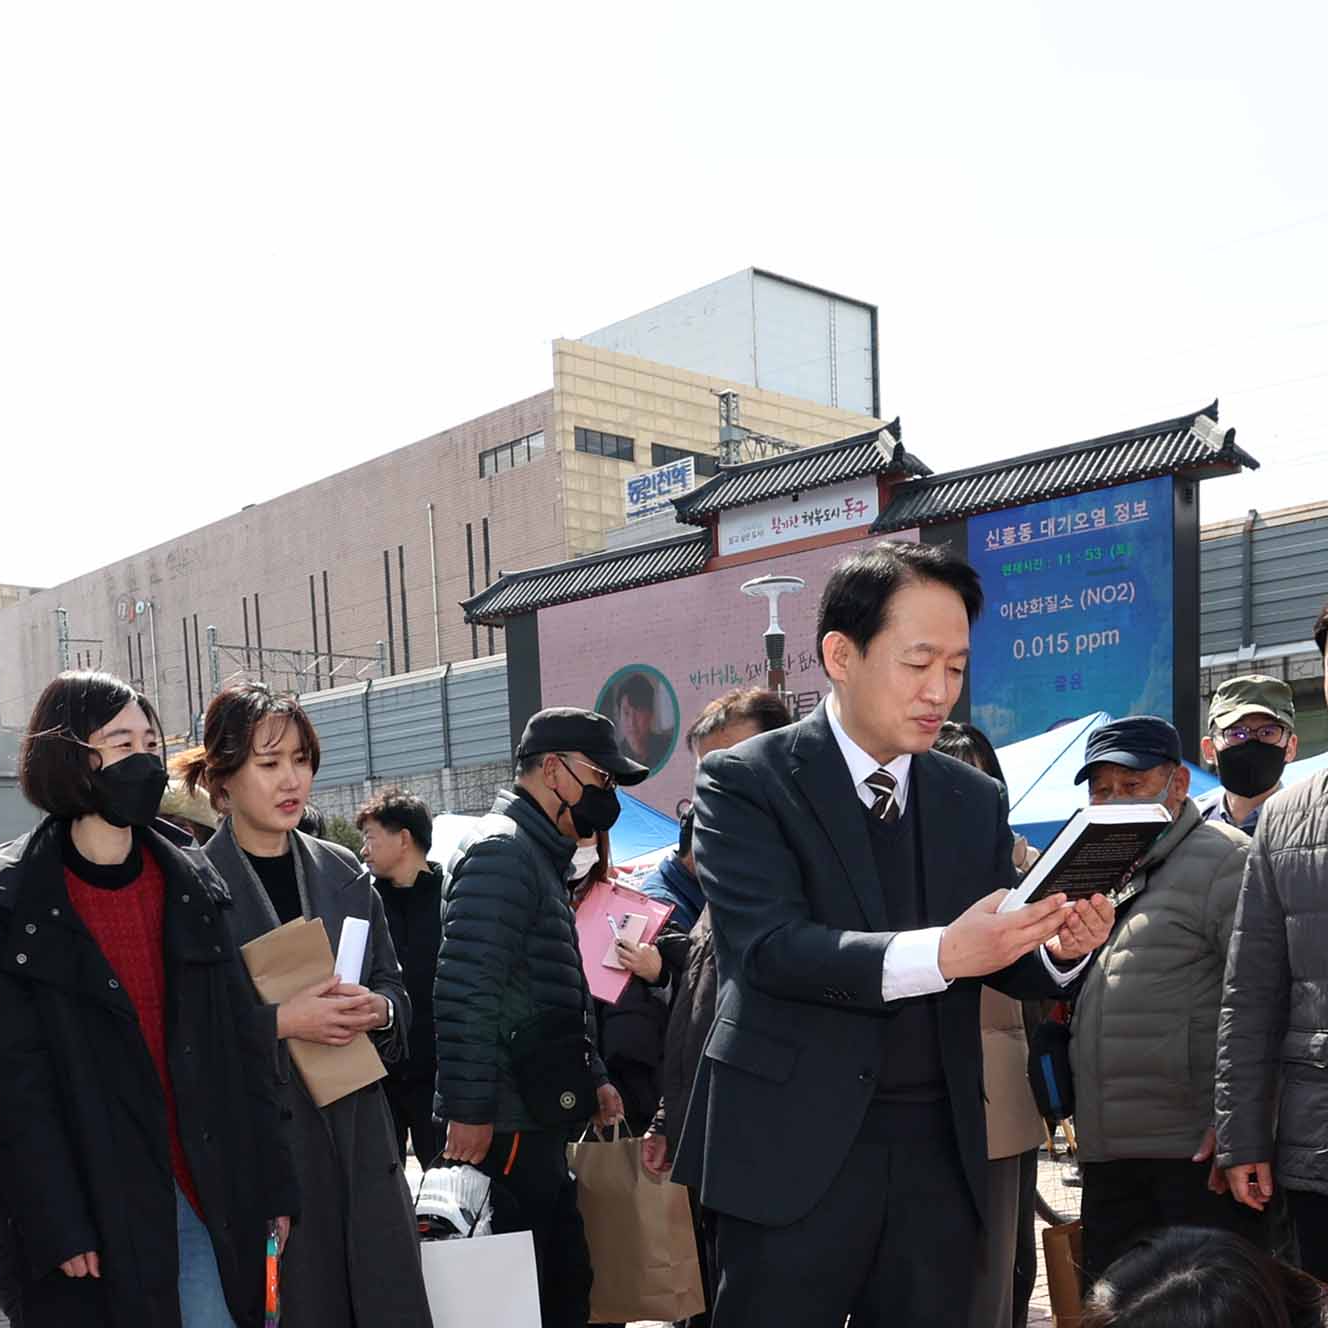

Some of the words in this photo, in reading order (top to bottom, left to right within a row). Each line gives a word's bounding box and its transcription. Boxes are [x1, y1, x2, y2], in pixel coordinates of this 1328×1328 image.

[770, 514, 799, 535] 활기찬
[840, 497, 870, 521] 동구
[985, 522, 1033, 548] 신흥동
[1040, 507, 1106, 537] 대기오염
[1114, 500, 1149, 522] 정보
[1000, 594, 1074, 620] 이산화질소
[1080, 581, 1136, 610] (NO2)
[1013, 632, 1070, 660] 0.015
[1076, 629, 1120, 656] ppm
